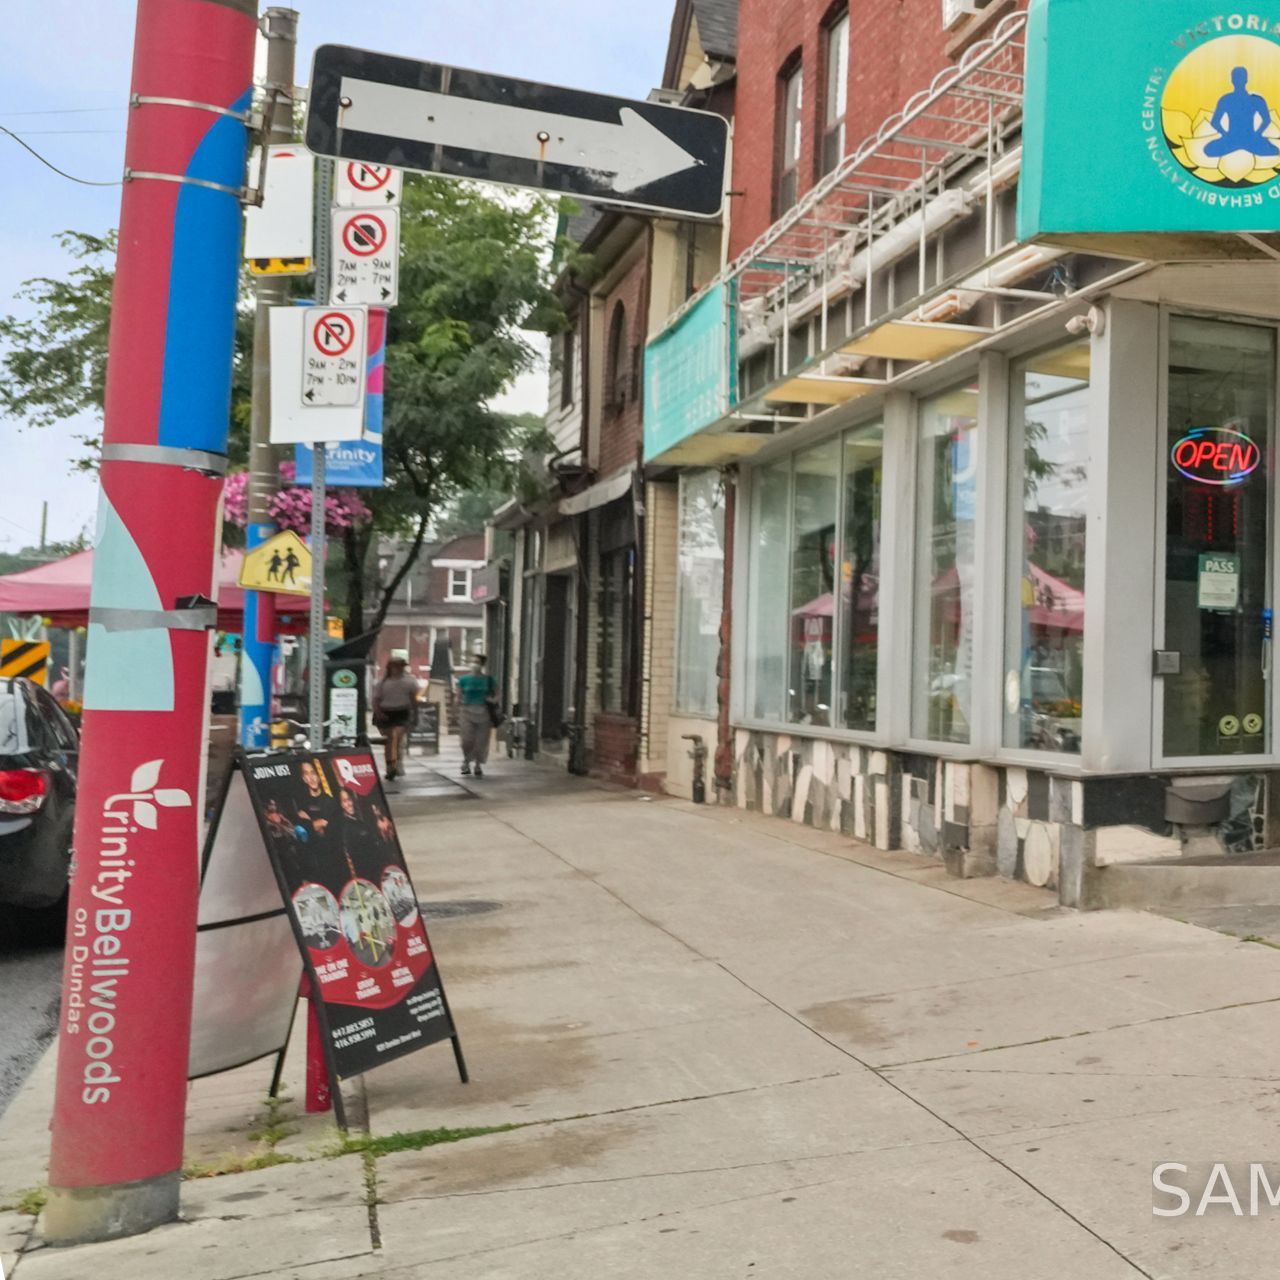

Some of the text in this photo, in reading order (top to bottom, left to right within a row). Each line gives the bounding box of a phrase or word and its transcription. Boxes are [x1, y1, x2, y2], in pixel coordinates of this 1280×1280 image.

[339, 258, 391, 271] 7AM 9AM
[338, 358, 357, 370] 2PM
[306, 373, 357, 386] 7PM 10PM
[1176, 440, 1252, 471] OPEN
[1205, 560, 1235, 573] PASS
[253, 765, 291, 780] JOIN US!
[67, 908, 90, 1035] on Dundas
[82, 908, 132, 1105] Bellwoods
